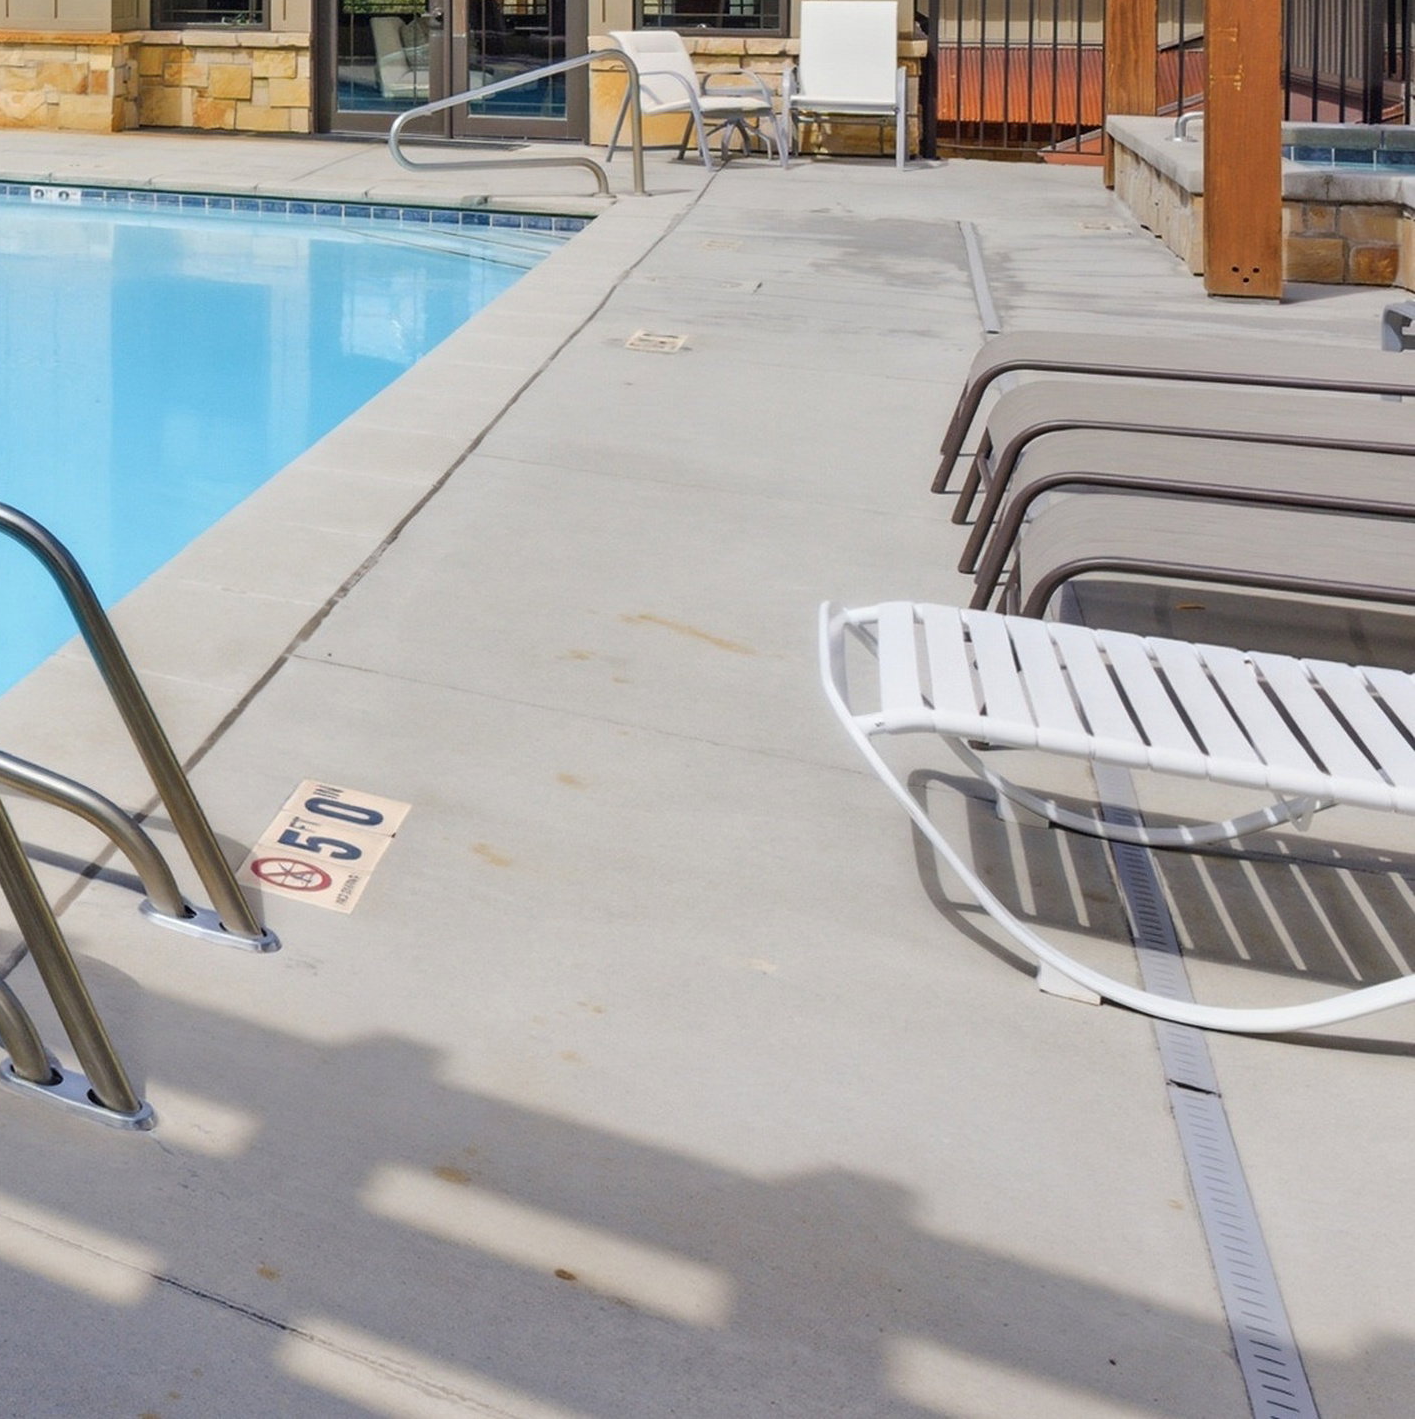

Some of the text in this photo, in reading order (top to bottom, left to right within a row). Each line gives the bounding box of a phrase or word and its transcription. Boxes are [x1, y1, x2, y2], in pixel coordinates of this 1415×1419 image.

[277, 784, 384, 860] 5 FT 0 IN
